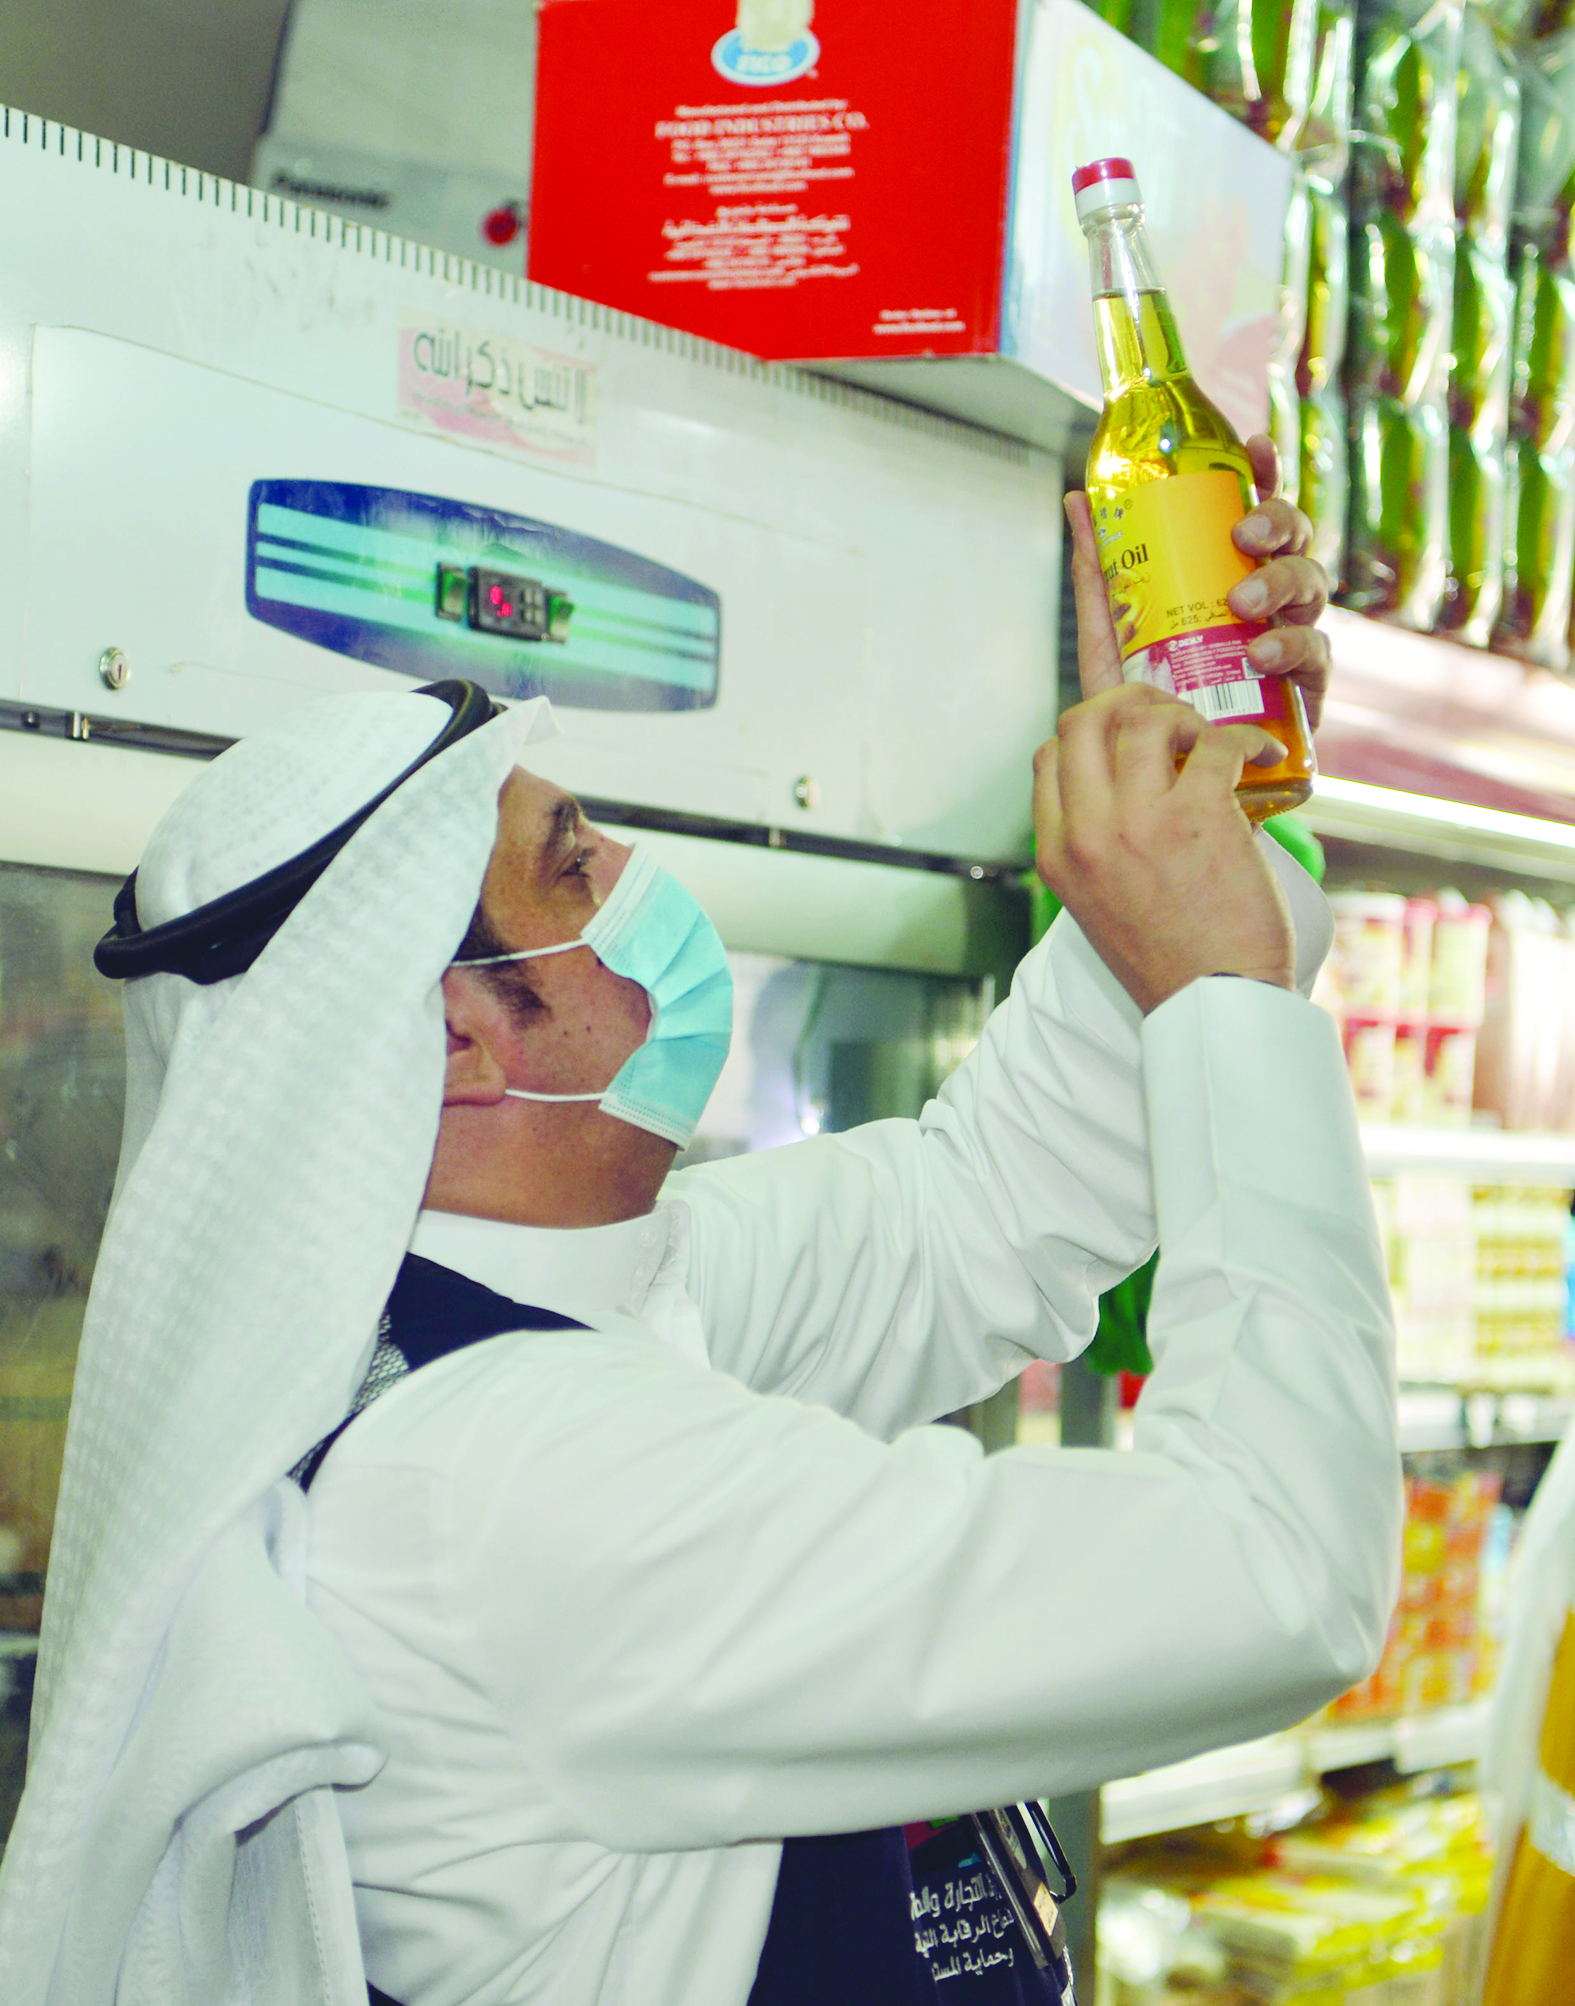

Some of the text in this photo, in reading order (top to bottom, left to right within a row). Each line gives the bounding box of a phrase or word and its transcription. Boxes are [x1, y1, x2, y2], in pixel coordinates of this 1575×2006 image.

[1121, 543, 1150, 569] Oil
[1166, 606, 1185, 618] NET
[1187, 601, 1209, 612] VOL
[944, 1872, 988, 1913] التجارة
[939, 1913, 991, 1949] الرقابة
[963, 1947, 1015, 1977] وحماية
